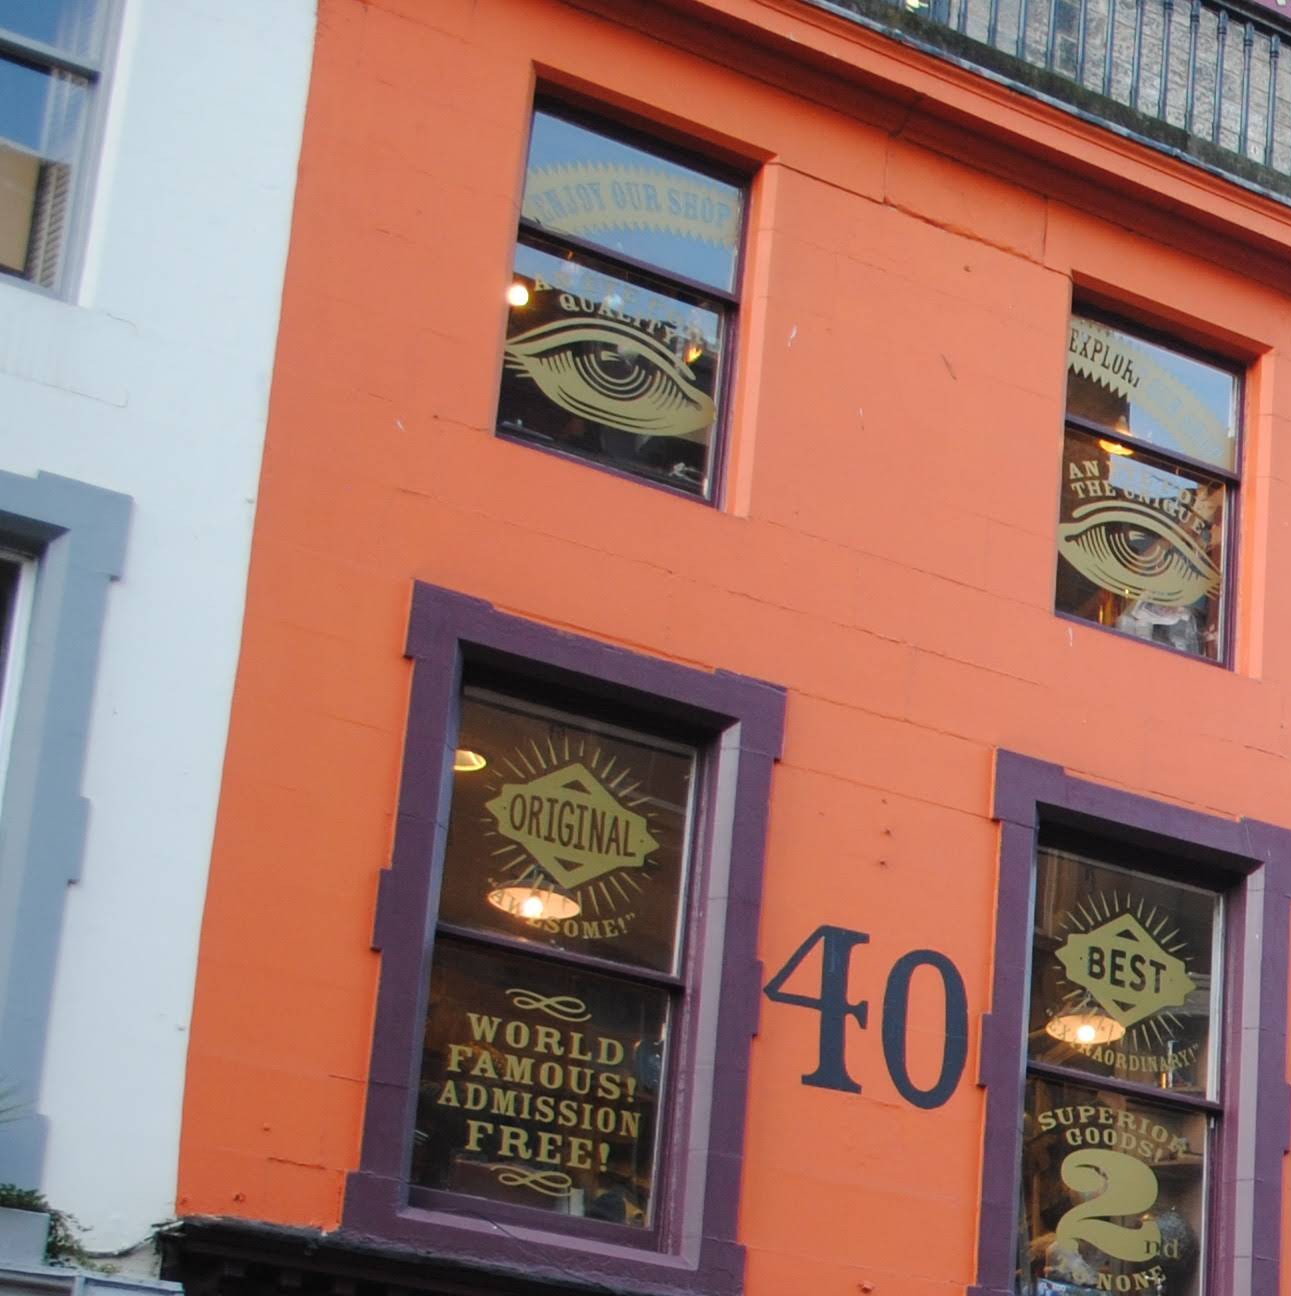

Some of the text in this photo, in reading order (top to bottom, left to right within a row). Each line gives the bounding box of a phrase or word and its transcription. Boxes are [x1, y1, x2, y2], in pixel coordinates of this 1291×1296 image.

[611, 181, 664, 214] OUR
[667, 187, 733, 227] SHOP
[559, 292, 680, 345] QUALITY
[1069, 459, 1100, 480] AN
[1071, 479, 1117, 500] THE
[509, 793, 637, 858] ORIGINAL
[1087, 945, 1168, 994] BEST
[466, 1012, 625, 1066] WORLD
[763, 924, 969, 1110] 40
[447, 1043, 637, 1102] FAMOUS!
[437, 1079, 641, 1138] ADMISSION
[1038, 1105, 1190, 1158] SUPERIOR
[464, 1119, 611, 1172] FREE!
[1065, 1127, 1162, 1163] GOODS!
[1096, 1264, 1168, 1293] NONE
